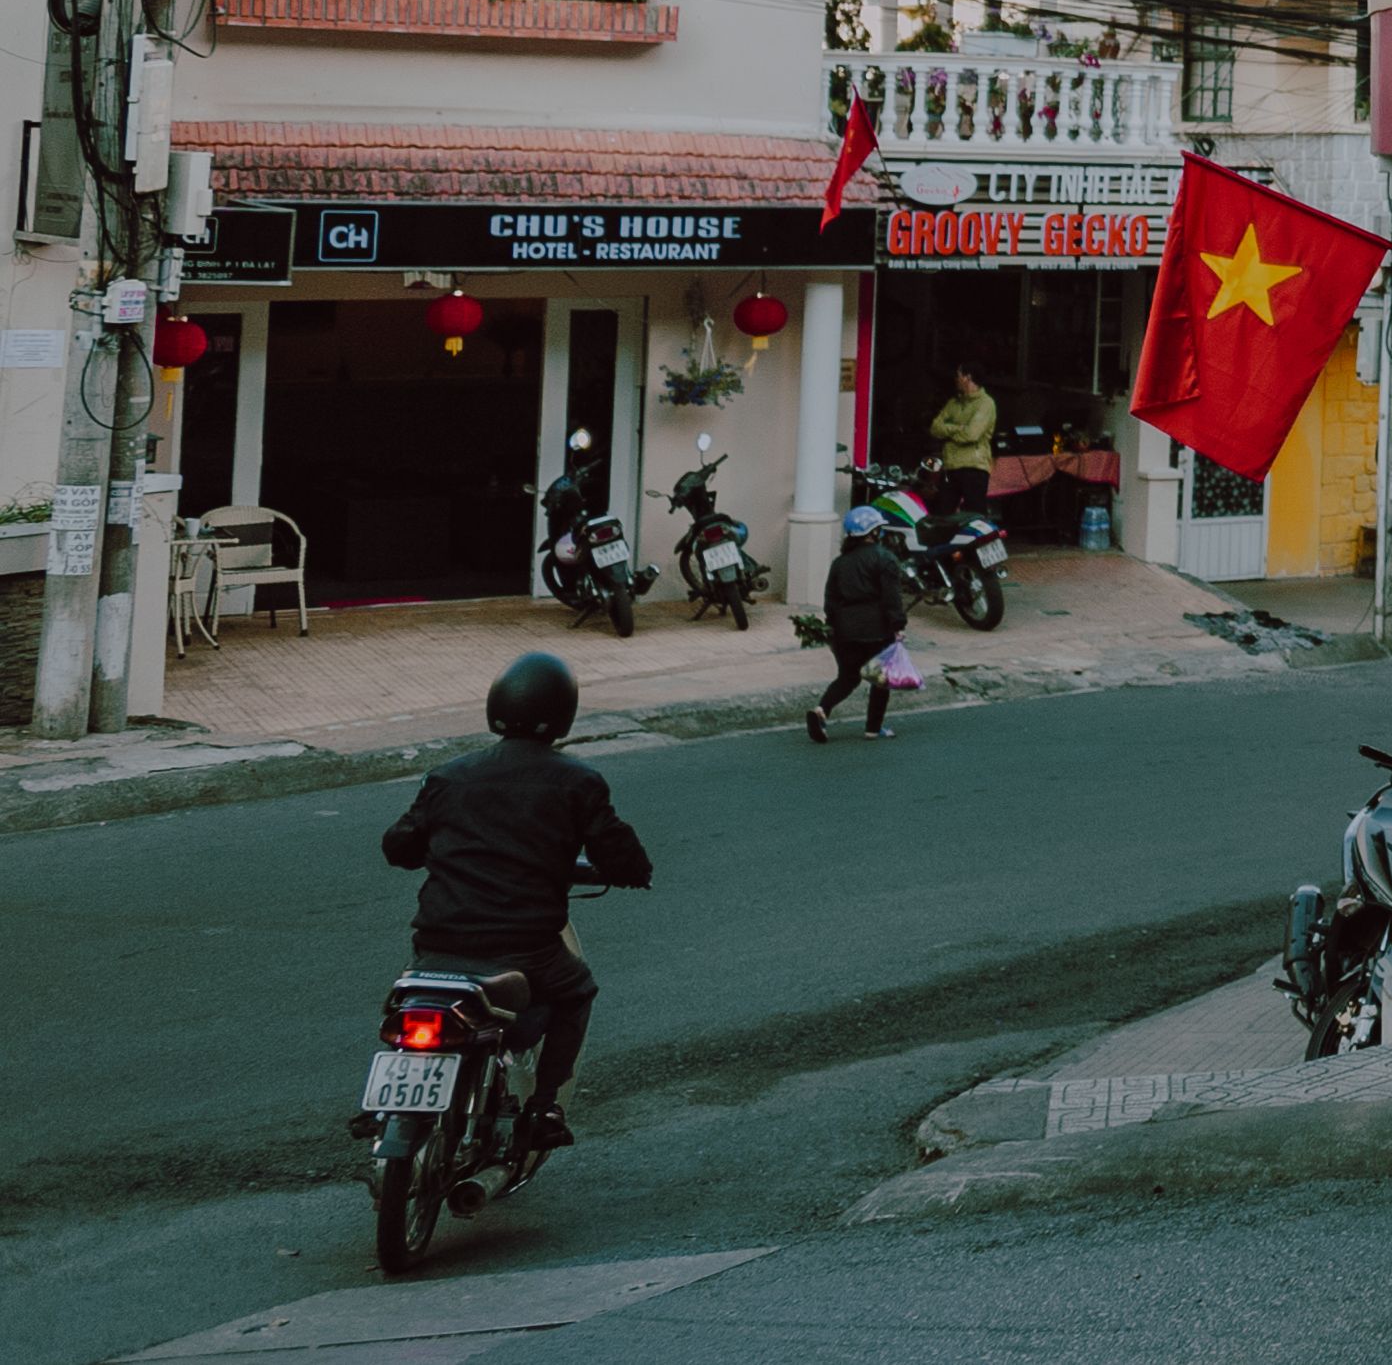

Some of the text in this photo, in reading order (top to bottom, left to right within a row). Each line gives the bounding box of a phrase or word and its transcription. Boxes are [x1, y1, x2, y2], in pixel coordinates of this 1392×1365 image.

[989, 164, 1037, 202] CTY
[490, 214, 741, 239] CHU'S HOUSE
[887, 209, 1149, 257] GROOVY GECKO
[512, 242, 577, 259] HOTEL
[596, 244, 719, 261] RESTAURANT
[71, 488, 97, 496] VAY
[419, 972, 468, 981] HONDA
[378, 1083, 443, 1107] 0505
